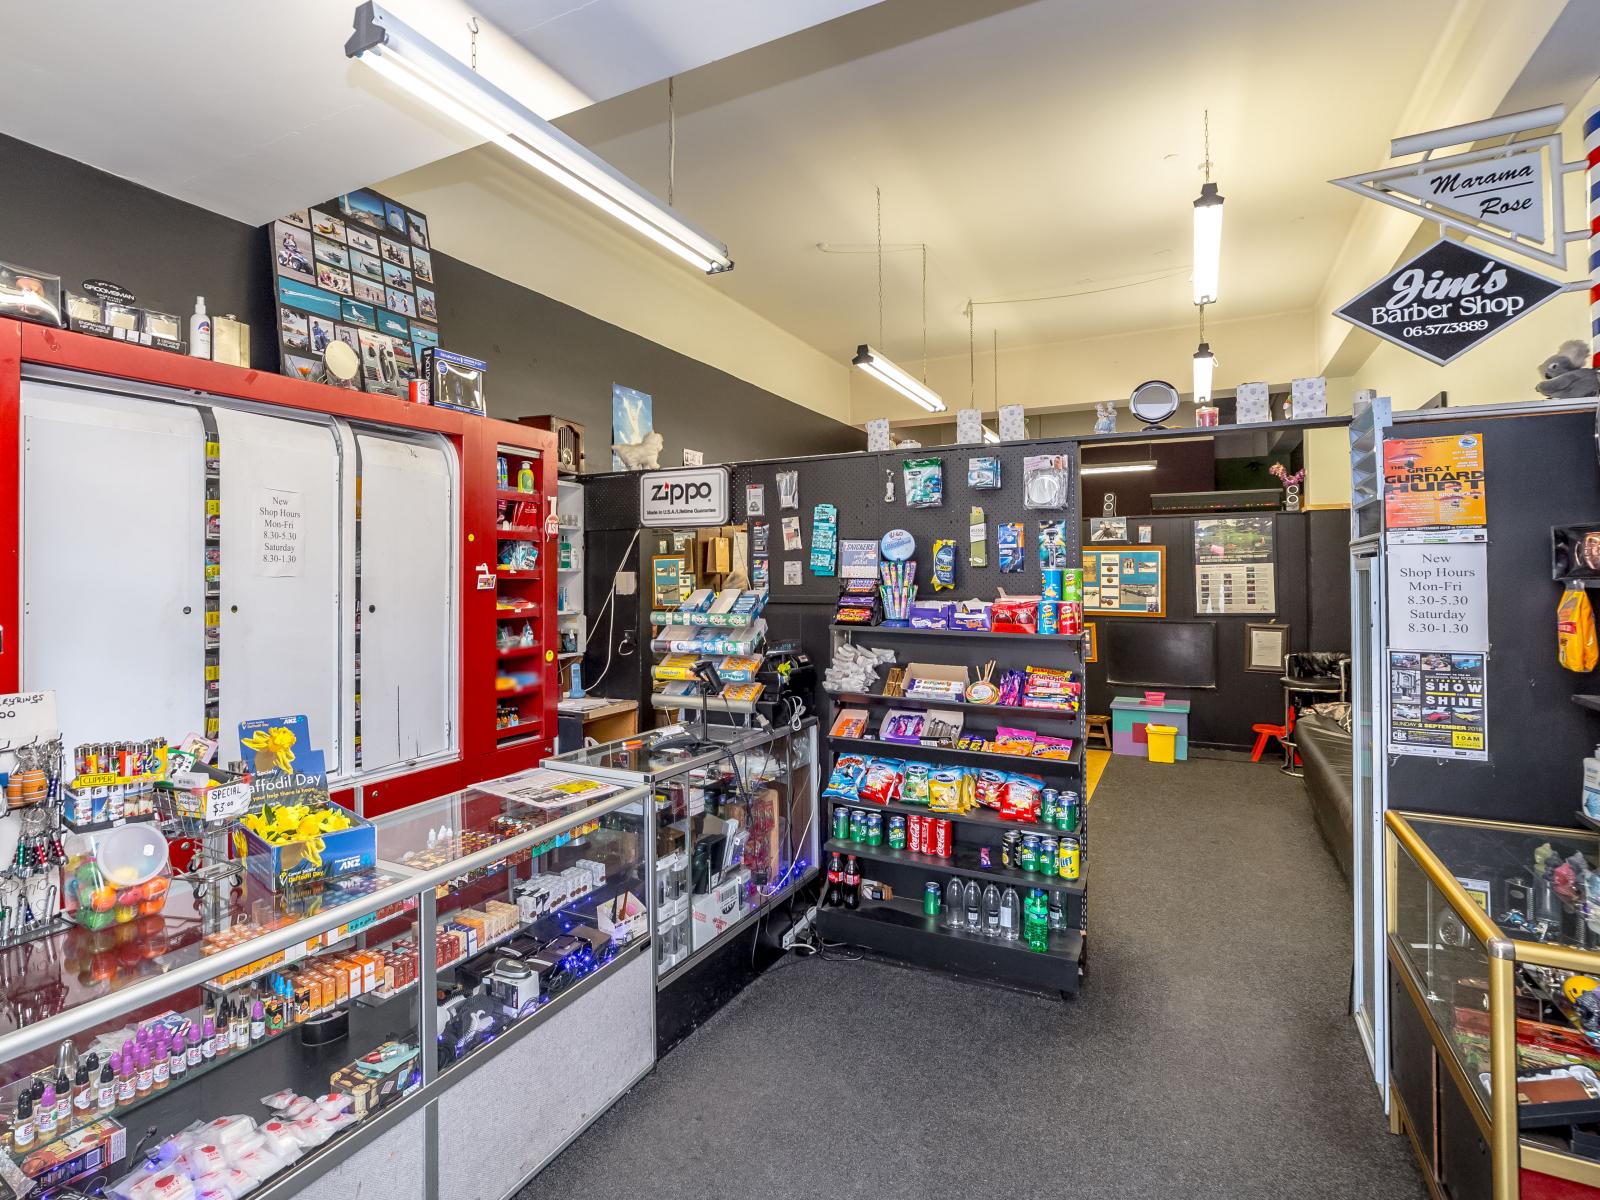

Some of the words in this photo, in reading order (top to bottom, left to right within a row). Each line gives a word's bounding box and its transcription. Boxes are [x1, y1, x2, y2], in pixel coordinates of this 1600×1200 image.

[1430, 164, 1535, 195] Marama
[1479, 197, 1533, 219] Rose
[1386, 261, 1508, 310] Jim's
[1371, 303, 1452, 326] Barber
[1460, 296, 1524, 316] Shop
[1403, 320, 1488, 337] 06-3773889
[1385, 470, 1484, 484] GURNARD
[272, 496, 288, 506] New
[260, 507, 278, 518] Shop
[280, 508, 300, 518] Hours
[264, 520, 294, 528] Mon-Fri
[264, 531, 296, 540] 8.30-5.30
[264, 543, 296, 553] Saturday
[263, 554, 296, 562] 8.30-1.30
[1422, 554, 1452, 564] New
[1400, 568, 1432, 580] Shop
[1436, 568, 1476, 578] Hours
[1409, 581, 1462, 592] Mon-Fri
[1408, 596, 1468, 606] 8.30-5.30
[1410, 610, 1466, 622] Saturday
[1408, 623, 1469, 634] 8.30-1.30
[1425, 682, 1483, 692] SHOW
[1426, 696, 1482, 706] SHINE
[82, 775, 113, 784] CLIPPER
[249, 775, 292, 793] affodil
[296, 774, 321, 786] Day
[212, 786, 242, 800] SPECIAL
[340, 859, 361, 871] ANZ
[288, 874, 312, 883] Daffodil
